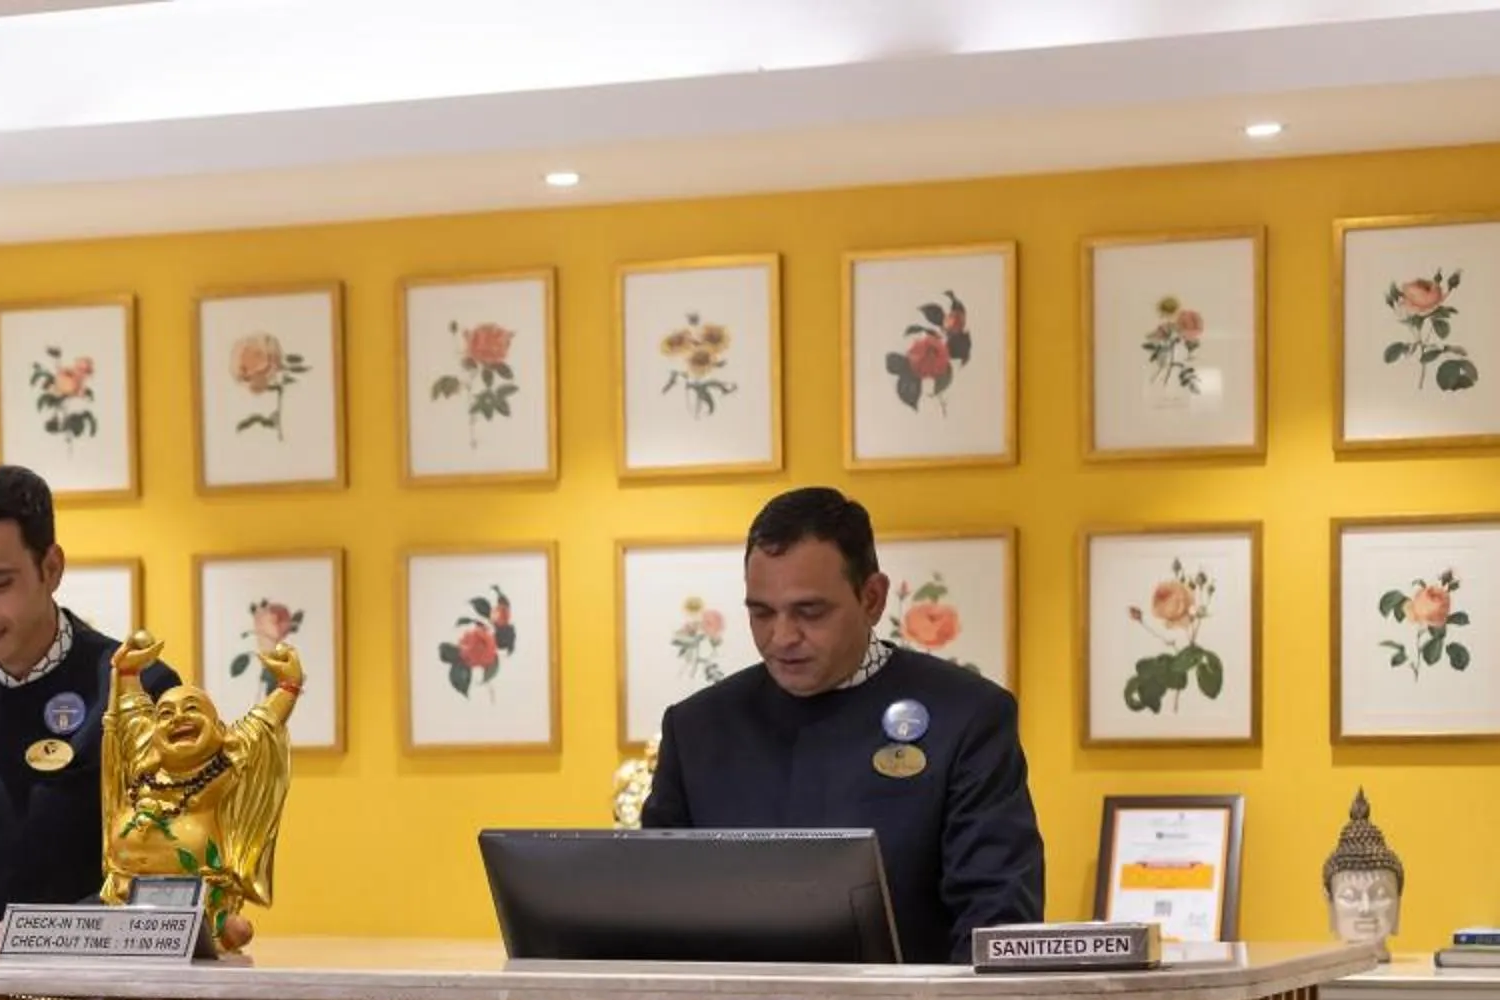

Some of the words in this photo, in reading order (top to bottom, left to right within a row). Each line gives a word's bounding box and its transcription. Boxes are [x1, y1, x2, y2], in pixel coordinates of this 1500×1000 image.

[15, 917, 73, 929] CHECK-IN
[76, 917, 103, 930] TIME
[161, 919, 187, 931] HRS
[11, 935, 80, 948] CHECK-OUT
[83, 936, 111, 949] TIME
[155, 937, 181, 950] HRS
[991, 939, 1087, 957] SANITIZED
[1093, 937, 1130, 953] PEN
